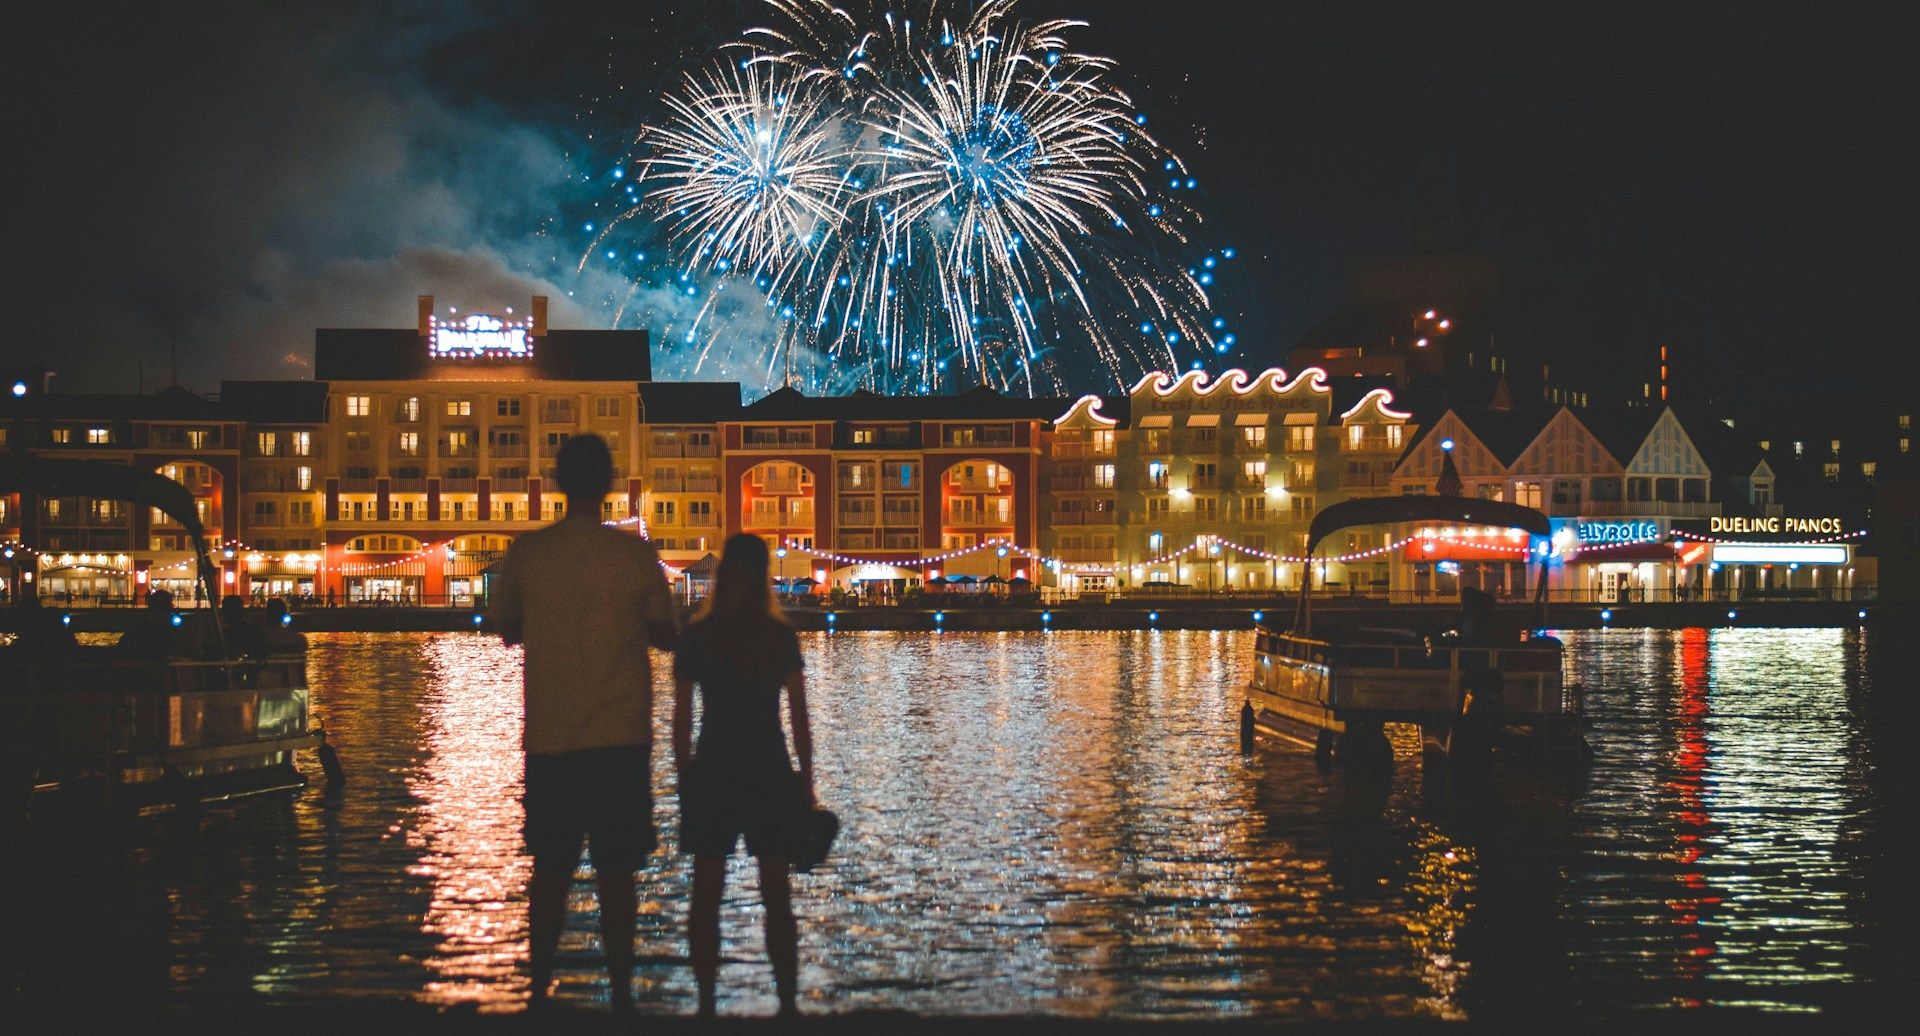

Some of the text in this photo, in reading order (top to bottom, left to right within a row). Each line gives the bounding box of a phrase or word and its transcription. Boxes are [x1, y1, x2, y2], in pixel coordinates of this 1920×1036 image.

[1579, 522, 1658, 541] ELLYROLLS
[1710, 516, 1843, 533] DUELING PIANOS
